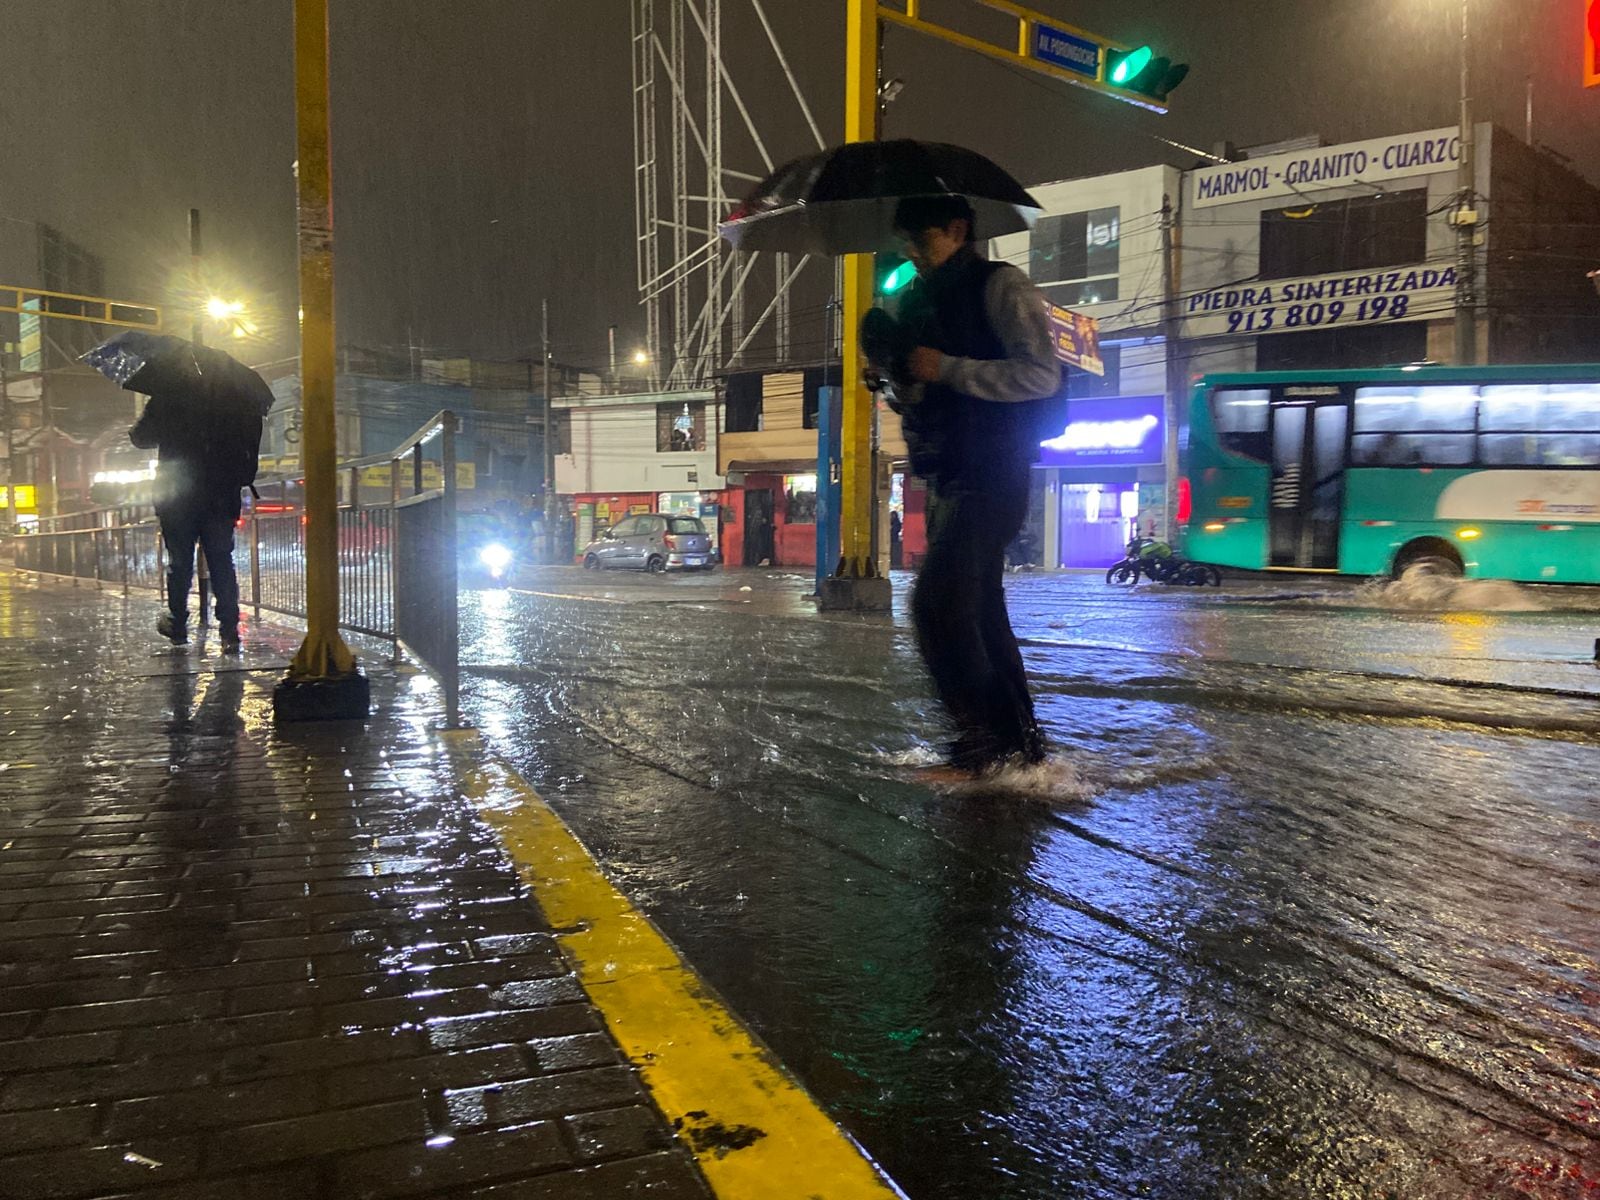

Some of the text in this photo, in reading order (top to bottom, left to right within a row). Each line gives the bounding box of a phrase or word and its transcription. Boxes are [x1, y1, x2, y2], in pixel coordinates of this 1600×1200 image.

[1198, 166, 1270, 200] MARMOL
[1286, 150, 1367, 184] GRANITO
[1189, 266, 1458, 312] PIEDRA SINTERIZADA
[1227, 294, 1409, 333] 913 809 198
